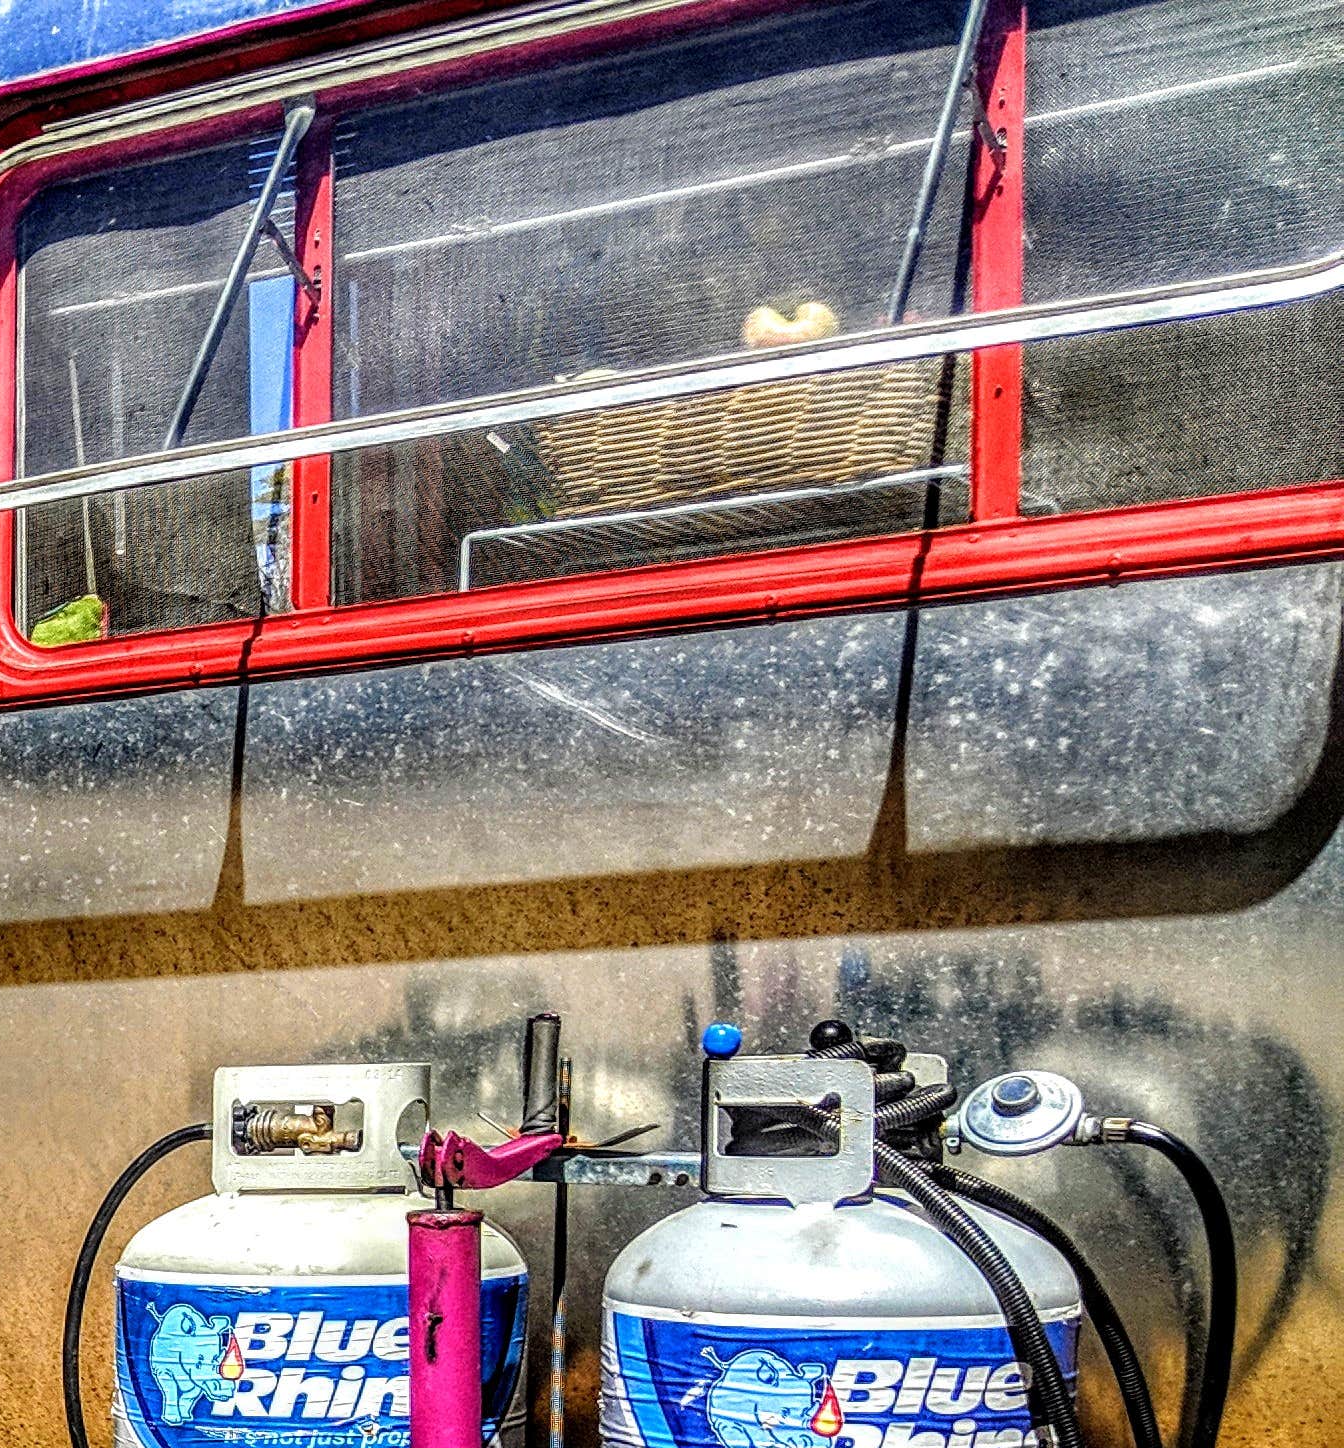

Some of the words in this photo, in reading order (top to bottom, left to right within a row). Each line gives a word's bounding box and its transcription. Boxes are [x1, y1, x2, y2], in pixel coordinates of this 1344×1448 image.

[235, 1311, 410, 1363] Blue
[211, 1365, 410, 1419] Rhin
[831, 1357, 1033, 1415] Blue
[263, 1430, 303, 1445] not
[306, 1429, 354, 1448] just
[361, 1431, 410, 1448] prop
